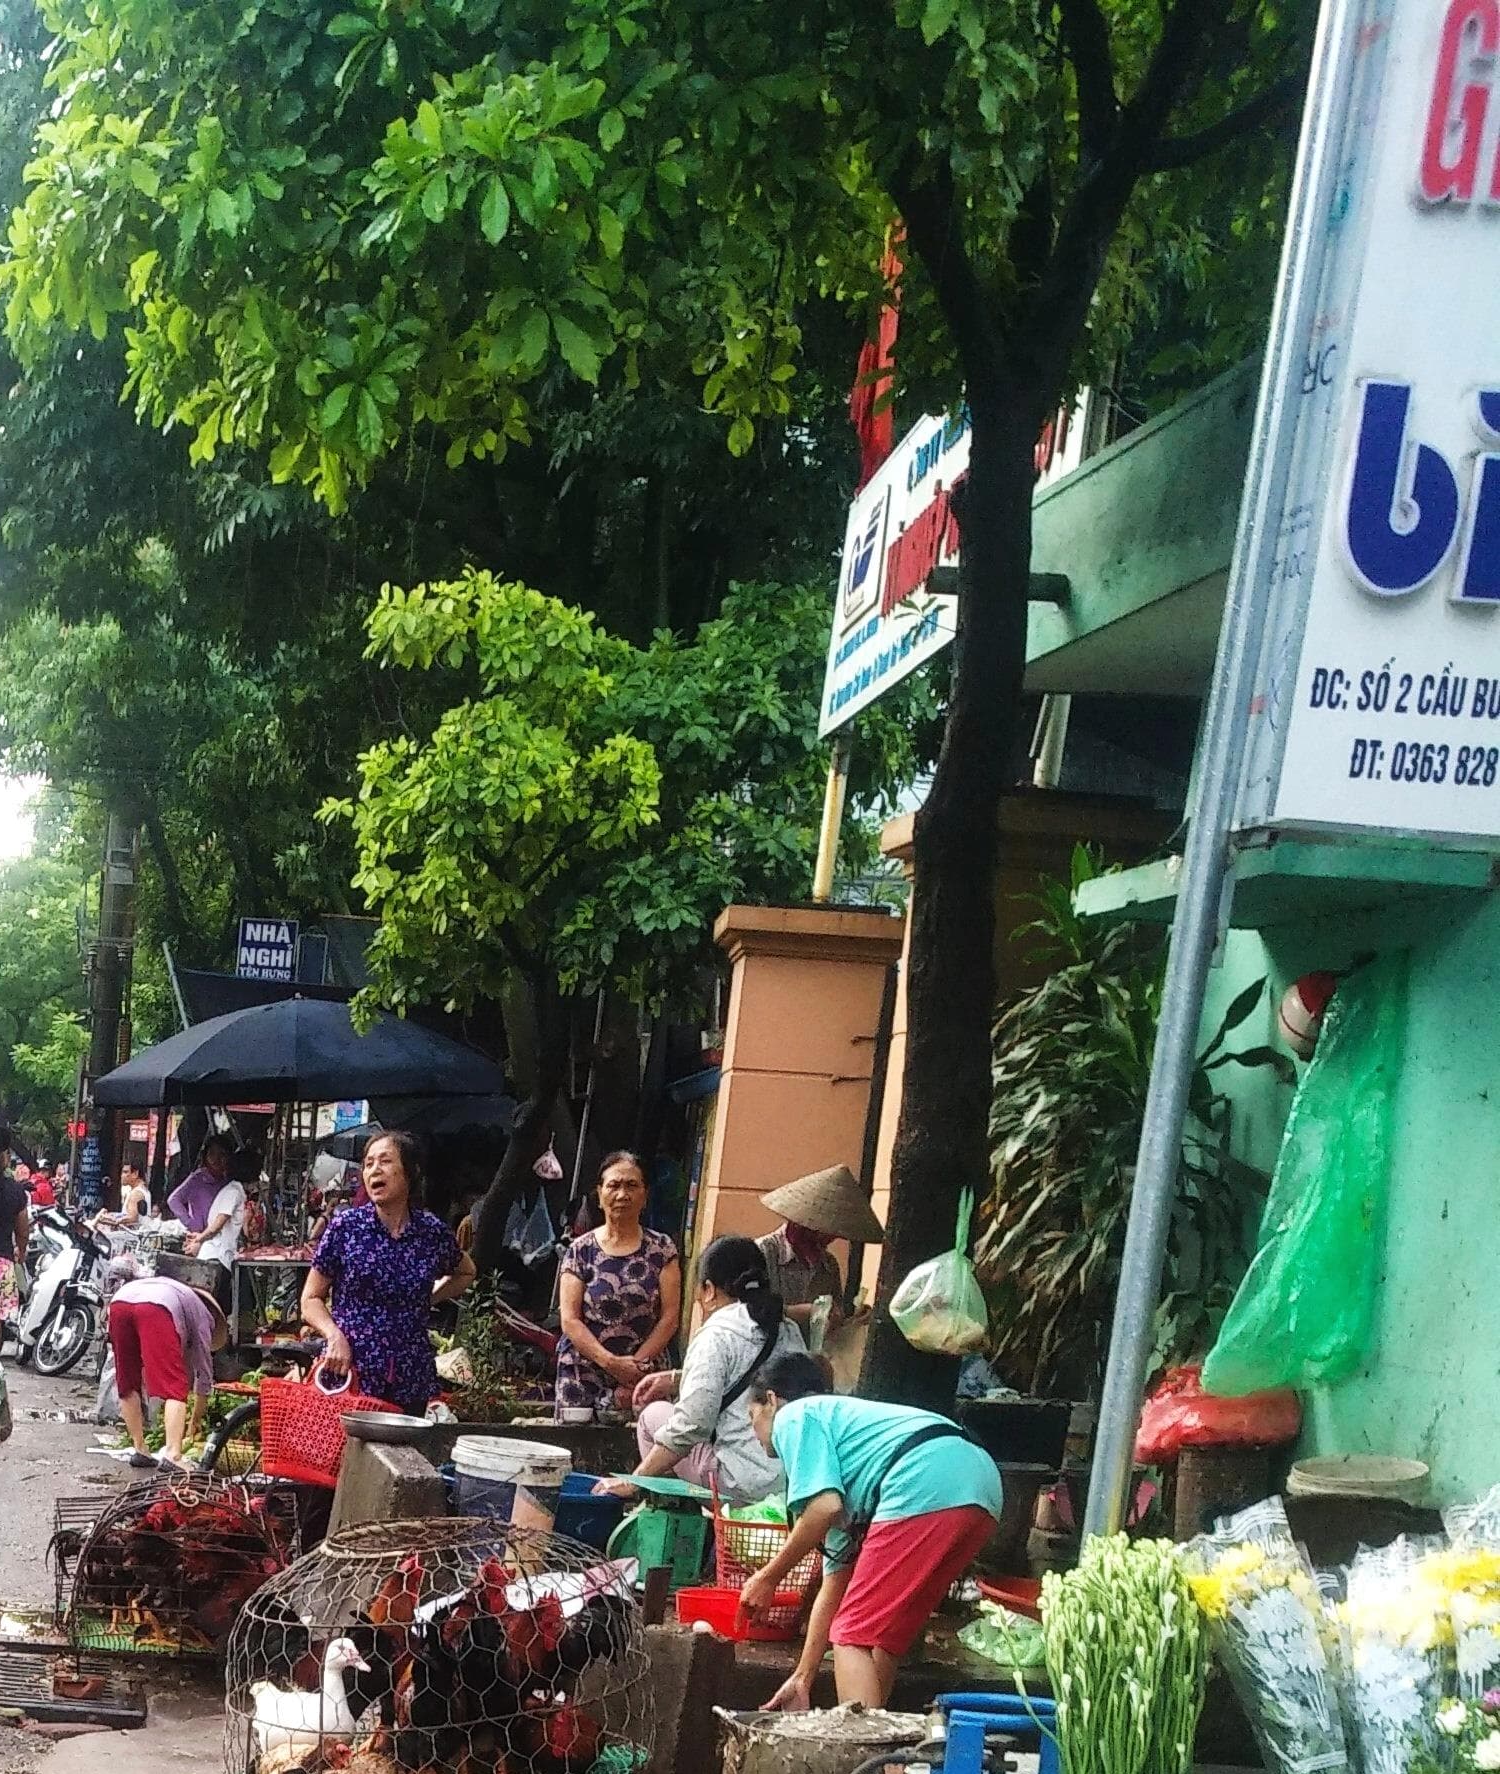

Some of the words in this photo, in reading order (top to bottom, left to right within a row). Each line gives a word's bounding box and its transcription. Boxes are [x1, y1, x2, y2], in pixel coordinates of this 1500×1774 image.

[1421, 0, 1500, 199] G
[1309, 667, 1351, 711] ĐC:
[1356, 656, 1397, 712] SỐ
[1394, 673, 1414, 714] 2
[1417, 661, 1468, 717] CẦU
[1348, 738, 1385, 780] ĐT:
[1390, 741, 1450, 784] 0363
[1454, 745, 1499, 788] 828
[245, 922, 291, 943] NHÀ
[239, 965, 260, 977] YÊN
[240, 944, 293, 968] NGHỈ
